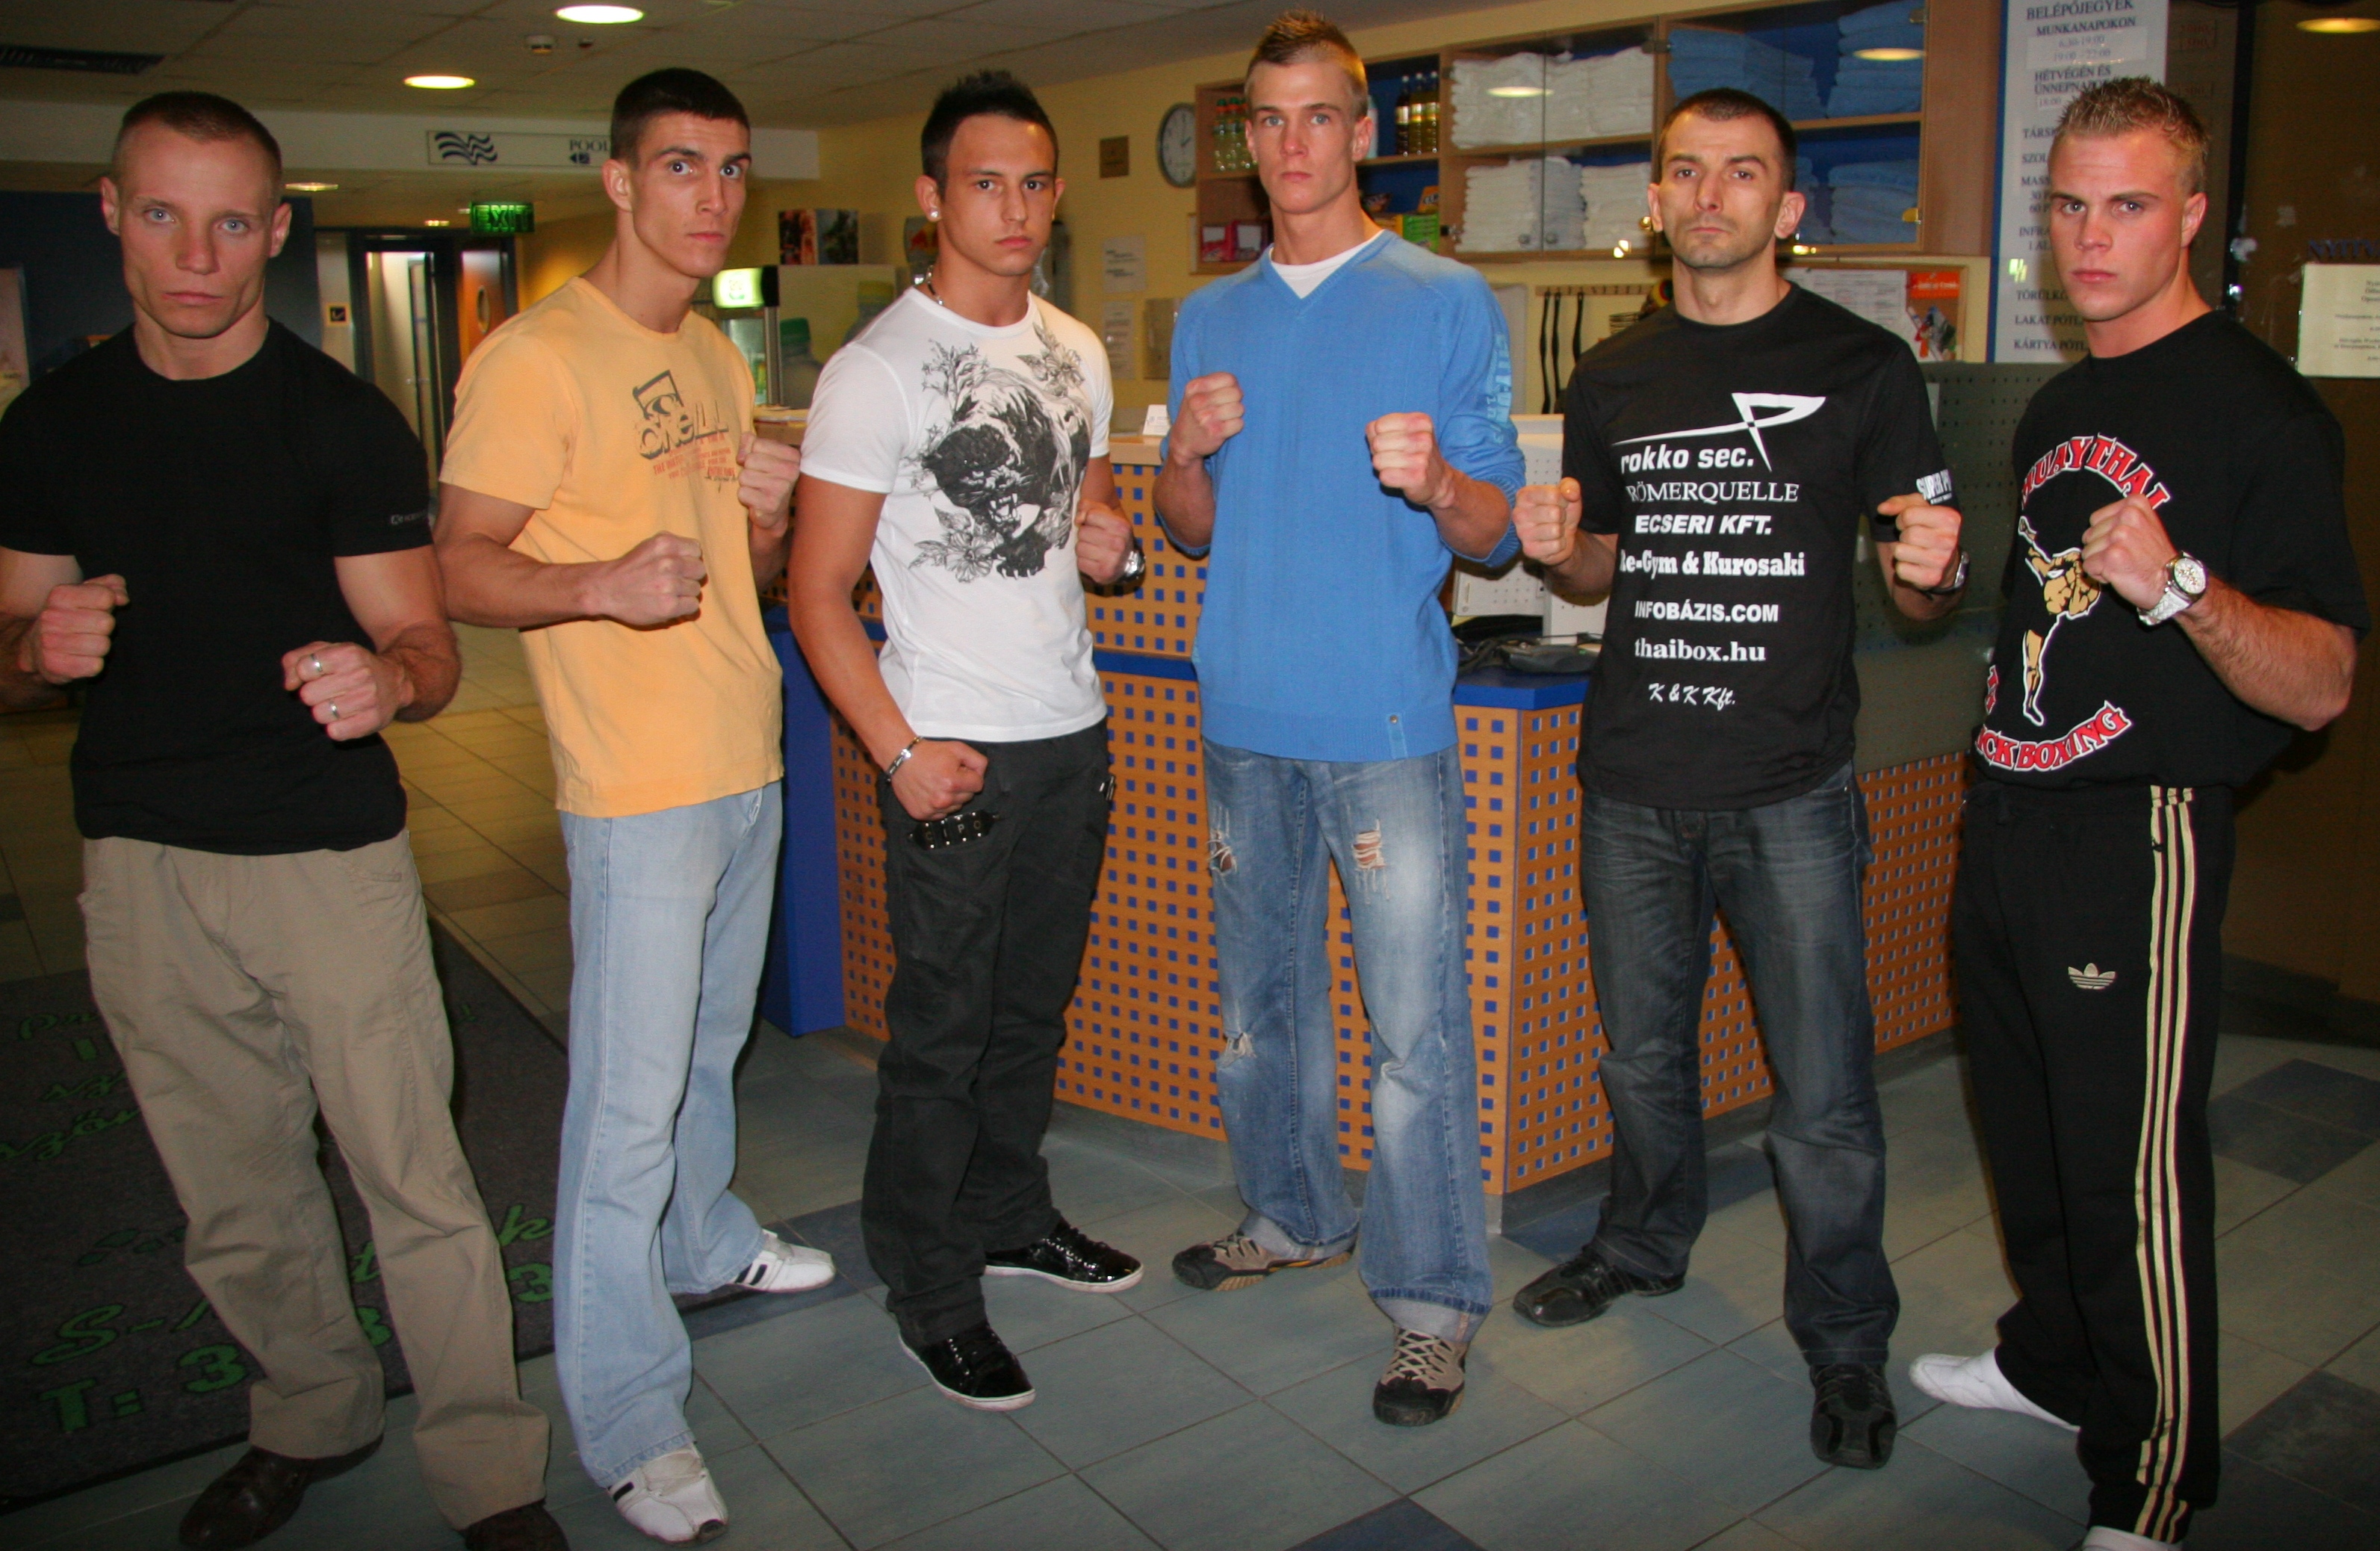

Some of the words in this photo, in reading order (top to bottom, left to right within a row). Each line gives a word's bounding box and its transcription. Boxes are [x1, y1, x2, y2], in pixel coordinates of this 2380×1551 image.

[2036, 16, 2136, 37] MUNKANAPOKON
[476, 204, 531, 232] EXIT
[1621, 444, 1689, 474] rokko
[1697, 448, 1754, 468] sec.
[1626, 480, 1800, 505] RÖMERQUELLE
[1634, 514, 1714, 534] ECSERI
[1719, 514, 1772, 535] KFT.
[1682, 551, 1699, 575] &
[1702, 551, 1805, 576] Kurosaki
[1634, 599, 1779, 622] INFOBÁZIS.COM
[1634, 637, 1766, 661] thaibox.hu
[1648, 683, 1665, 702] K
[1669, 683, 1680, 702] &
[1683, 686, 1700, 705] K
[1702, 687, 1736, 711] Kft.
